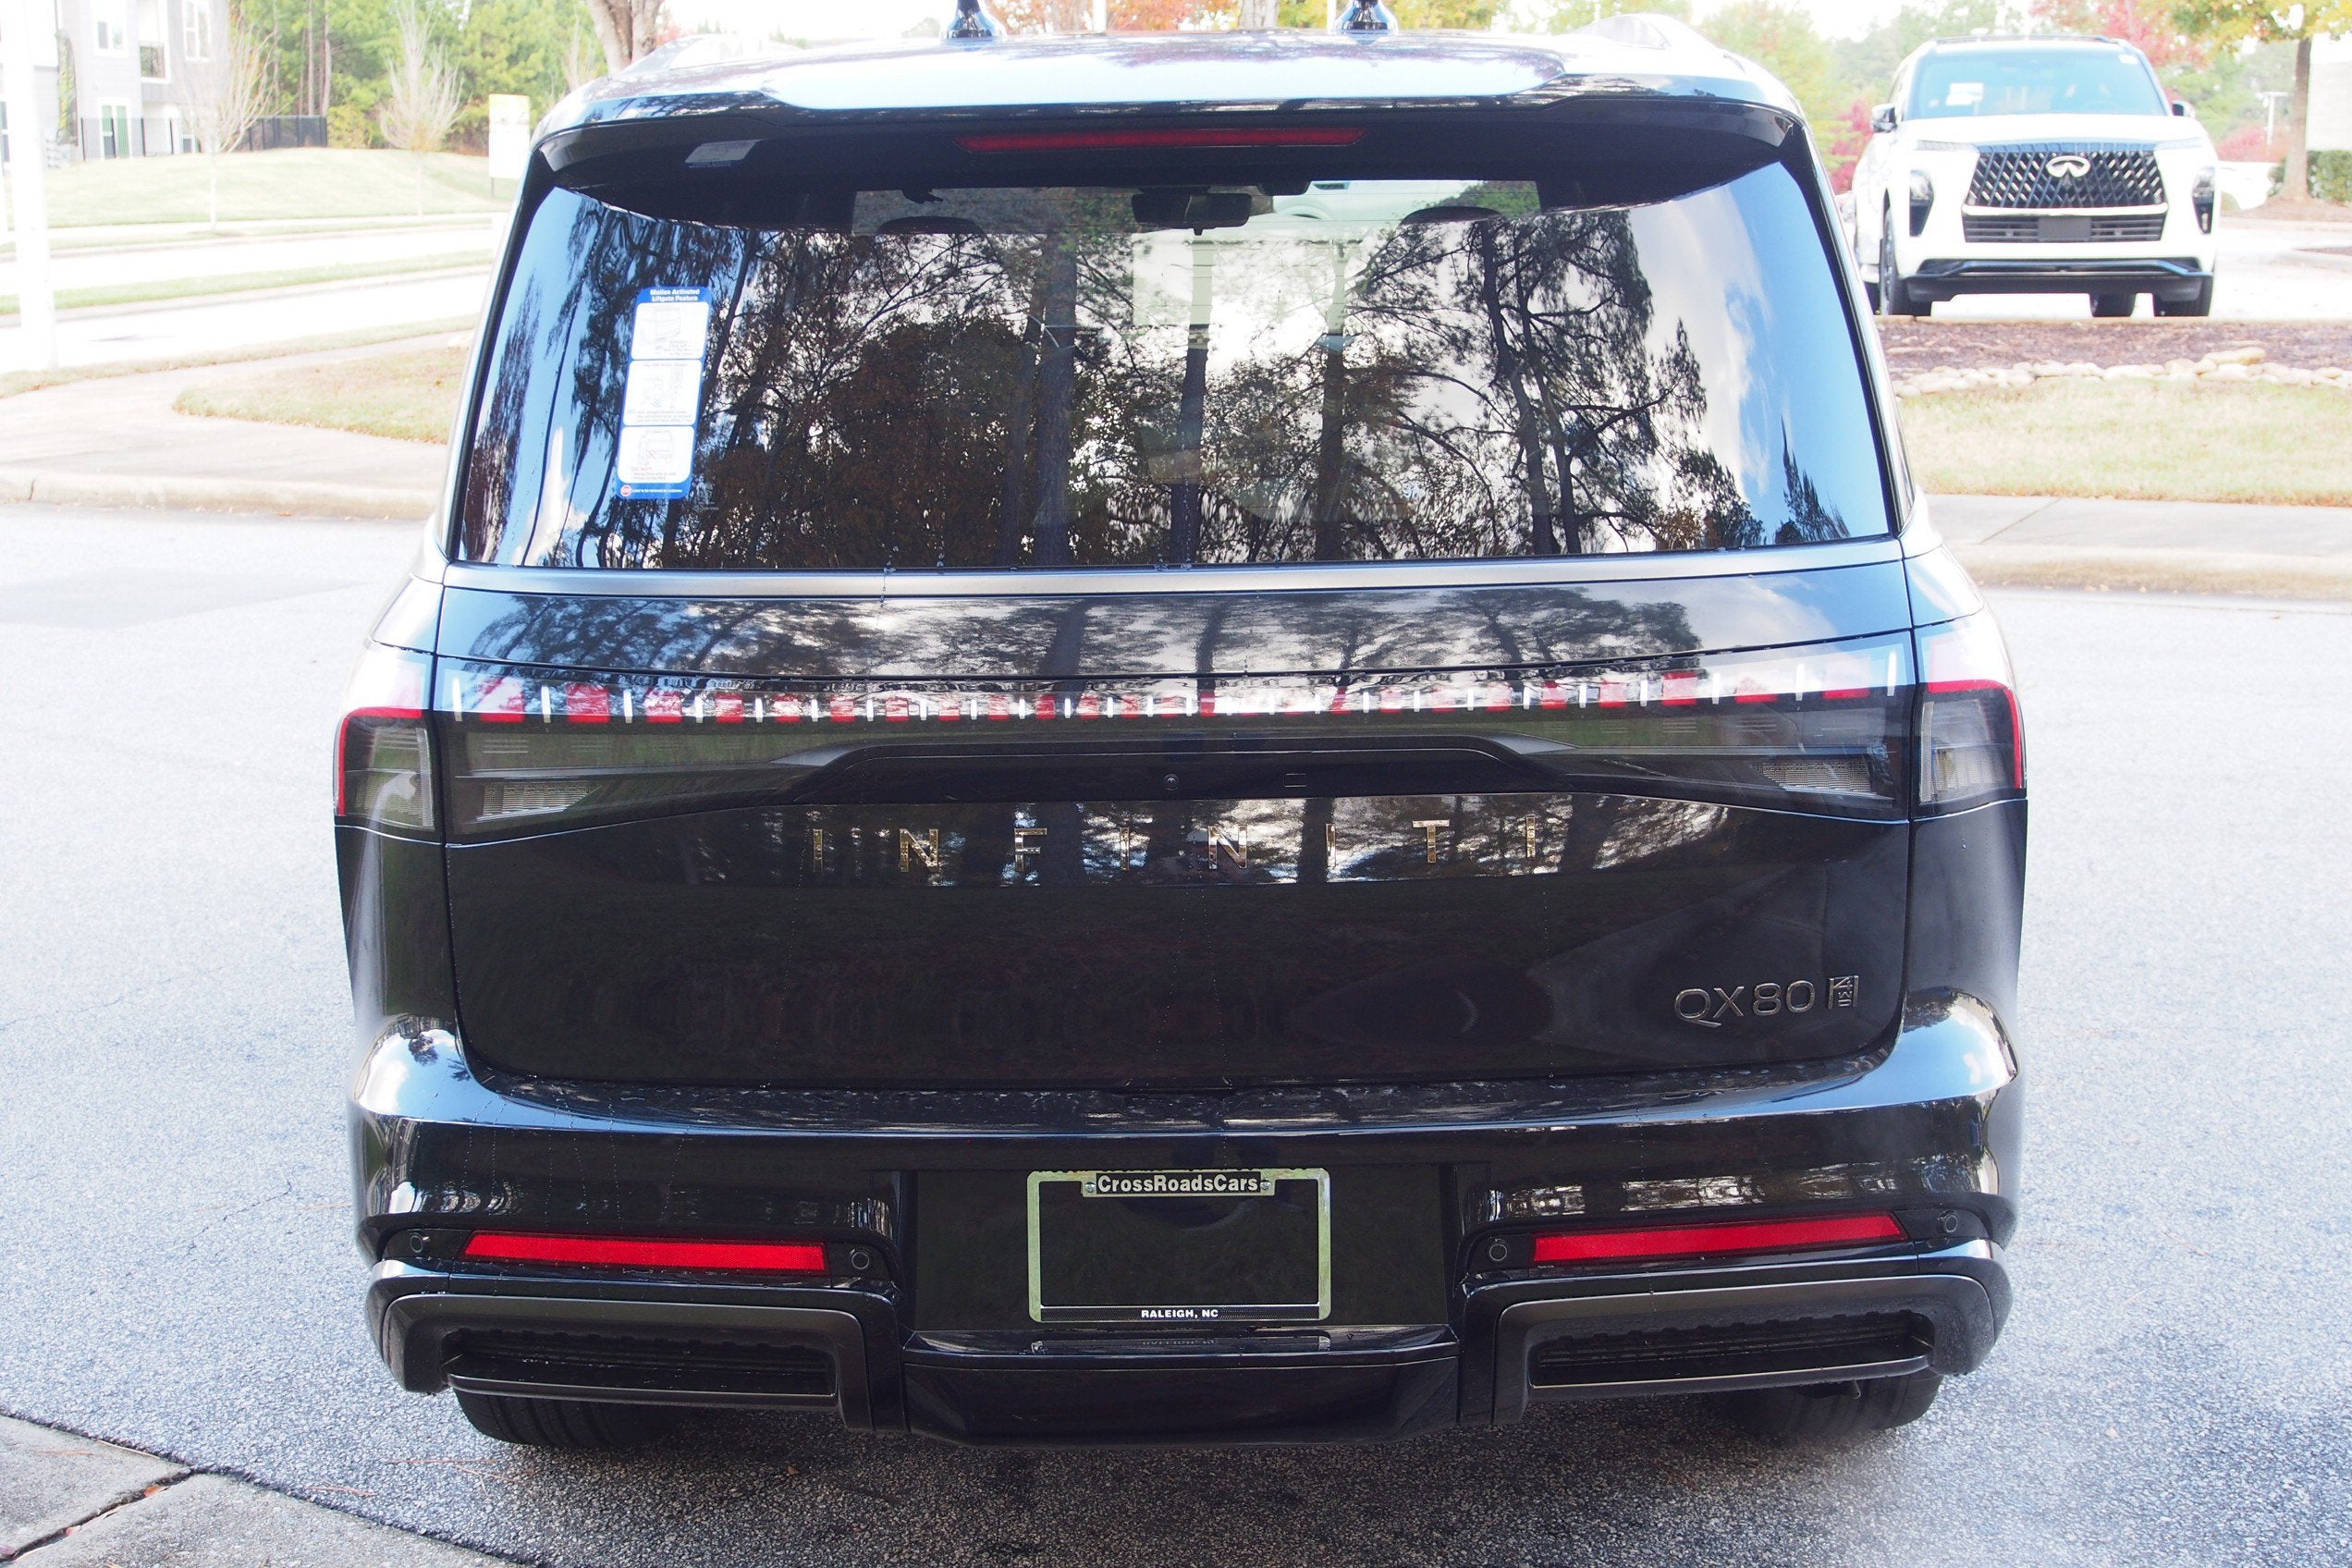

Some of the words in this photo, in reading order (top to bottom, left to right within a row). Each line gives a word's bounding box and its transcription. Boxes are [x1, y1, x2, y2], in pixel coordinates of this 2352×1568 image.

[812, 816, 1537, 874] INFINITI
[1673, 979, 1816, 1028] QX80
[1097, 1174, 1258, 1193] CrossRoadsCars
[1141, 1309, 1198, 1320] RALEIGH,
[1201, 1309, 1219, 1318] NC
